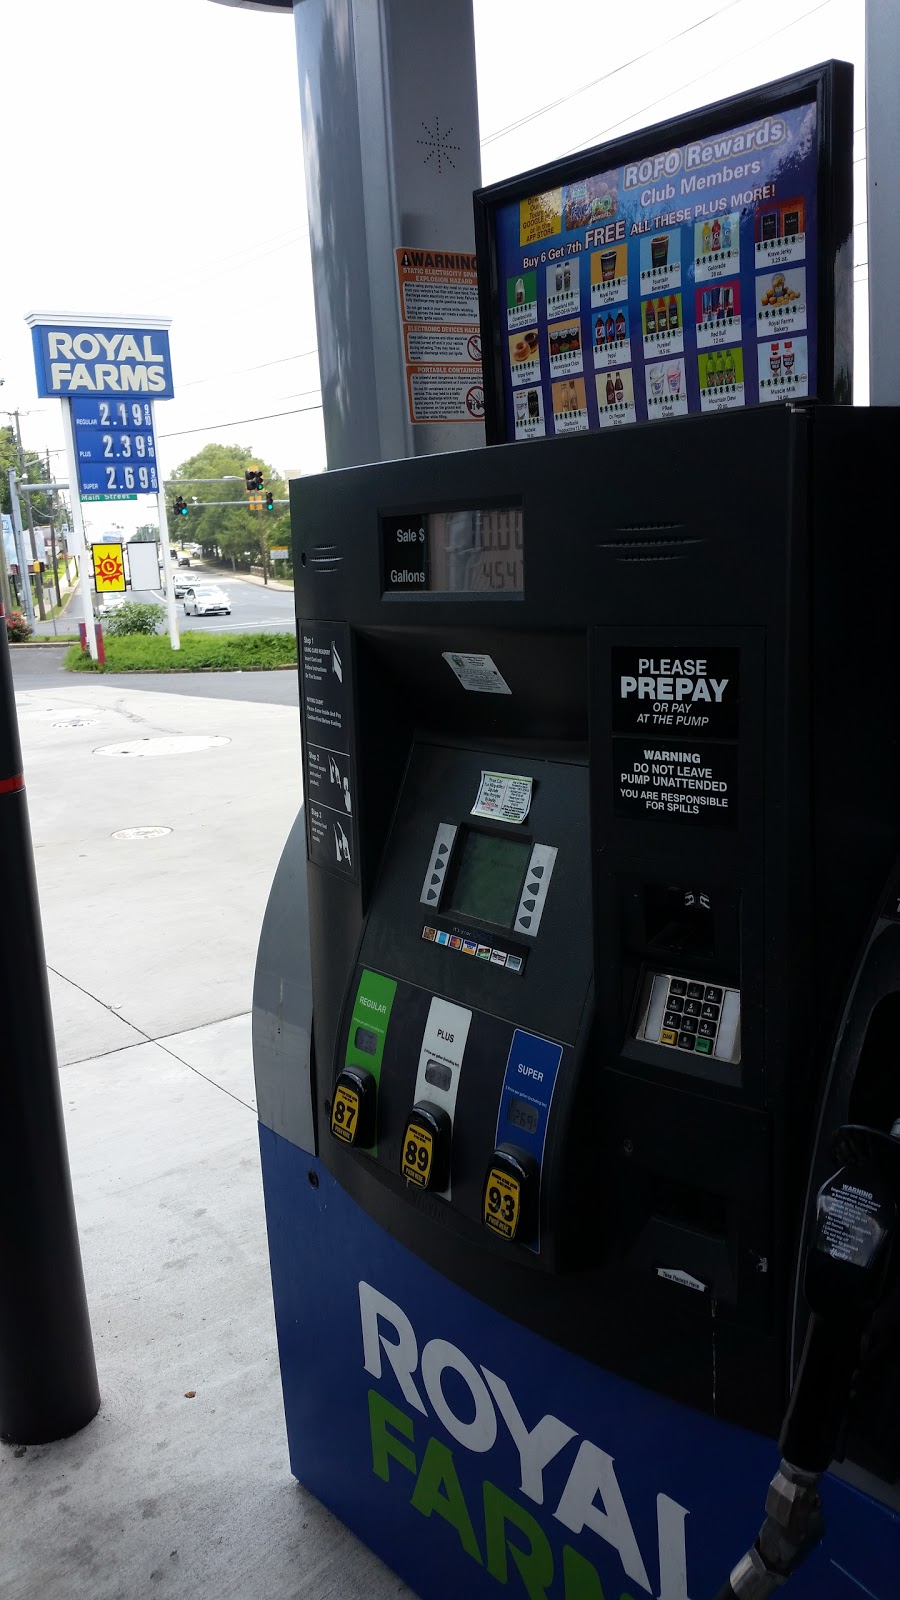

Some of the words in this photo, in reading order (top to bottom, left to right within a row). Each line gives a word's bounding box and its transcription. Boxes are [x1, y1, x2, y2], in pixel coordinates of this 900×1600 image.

[624, 150, 681, 189] ROFO
[686, 119, 785, 169] Rewards
[640, 183, 676, 207] Club
[680, 160, 761, 195] Members
[523, 257, 539, 269] Buy
[541, 252, 546, 263] 6
[548, 246, 564, 260] Get
[567, 240, 582, 255] 7th
[585, 220, 626, 250] FREE
[630, 219, 651, 236] ALL
[653, 207, 692, 229] THESE
[694, 198, 727, 218] PLUS
[731, 184, 776, 206] MORE!
[48, 332, 164, 363] ROYAL
[51, 362, 166, 392] FARMS
[99, 402, 142, 426] 2.19
[79, 450, 92, 458] PLUS
[102, 434, 146, 458] 2.39
[106, 466, 149, 490] 2.69
[396, 528, 417, 543] Sale
[418, 527, 425, 544] $
[390, 569, 426, 583] Gallons
[638, 658, 708, 676] PLEASE
[620, 675, 729, 703] PREPAY
[652, 702, 669, 713] OR
[671, 702, 693, 714] PAY
[636, 713, 650, 724] AT
[652, 714, 674, 725] THE
[675, 715, 710, 727] PUMP
[643, 749, 701, 764] WARNING
[633, 762, 650, 773] DO
[651, 764, 675, 775] NOT
[677, 766, 713, 779] LEAVE
[620, 773, 650, 785] PUMP
[652, 776, 728, 793] UNATTENDED
[619, 788, 639, 799] YOU
[640, 790, 659, 801] ARE
[661, 792, 729, 808] RESPONSIBLE
[645, 801, 665, 811] FOR
[666, 802, 700, 815] SPILLS
[359, 995, 387, 1015] REGULAR
[436, 1028, 455, 1043] PLUS
[516, 1062, 545, 1083] SUPER
[334, 1100, 356, 1129] 87
[405, 1140, 429, 1172] 89
[842, 1183, 874, 1200] WARNING
[488, 1186, 515, 1222] 93
